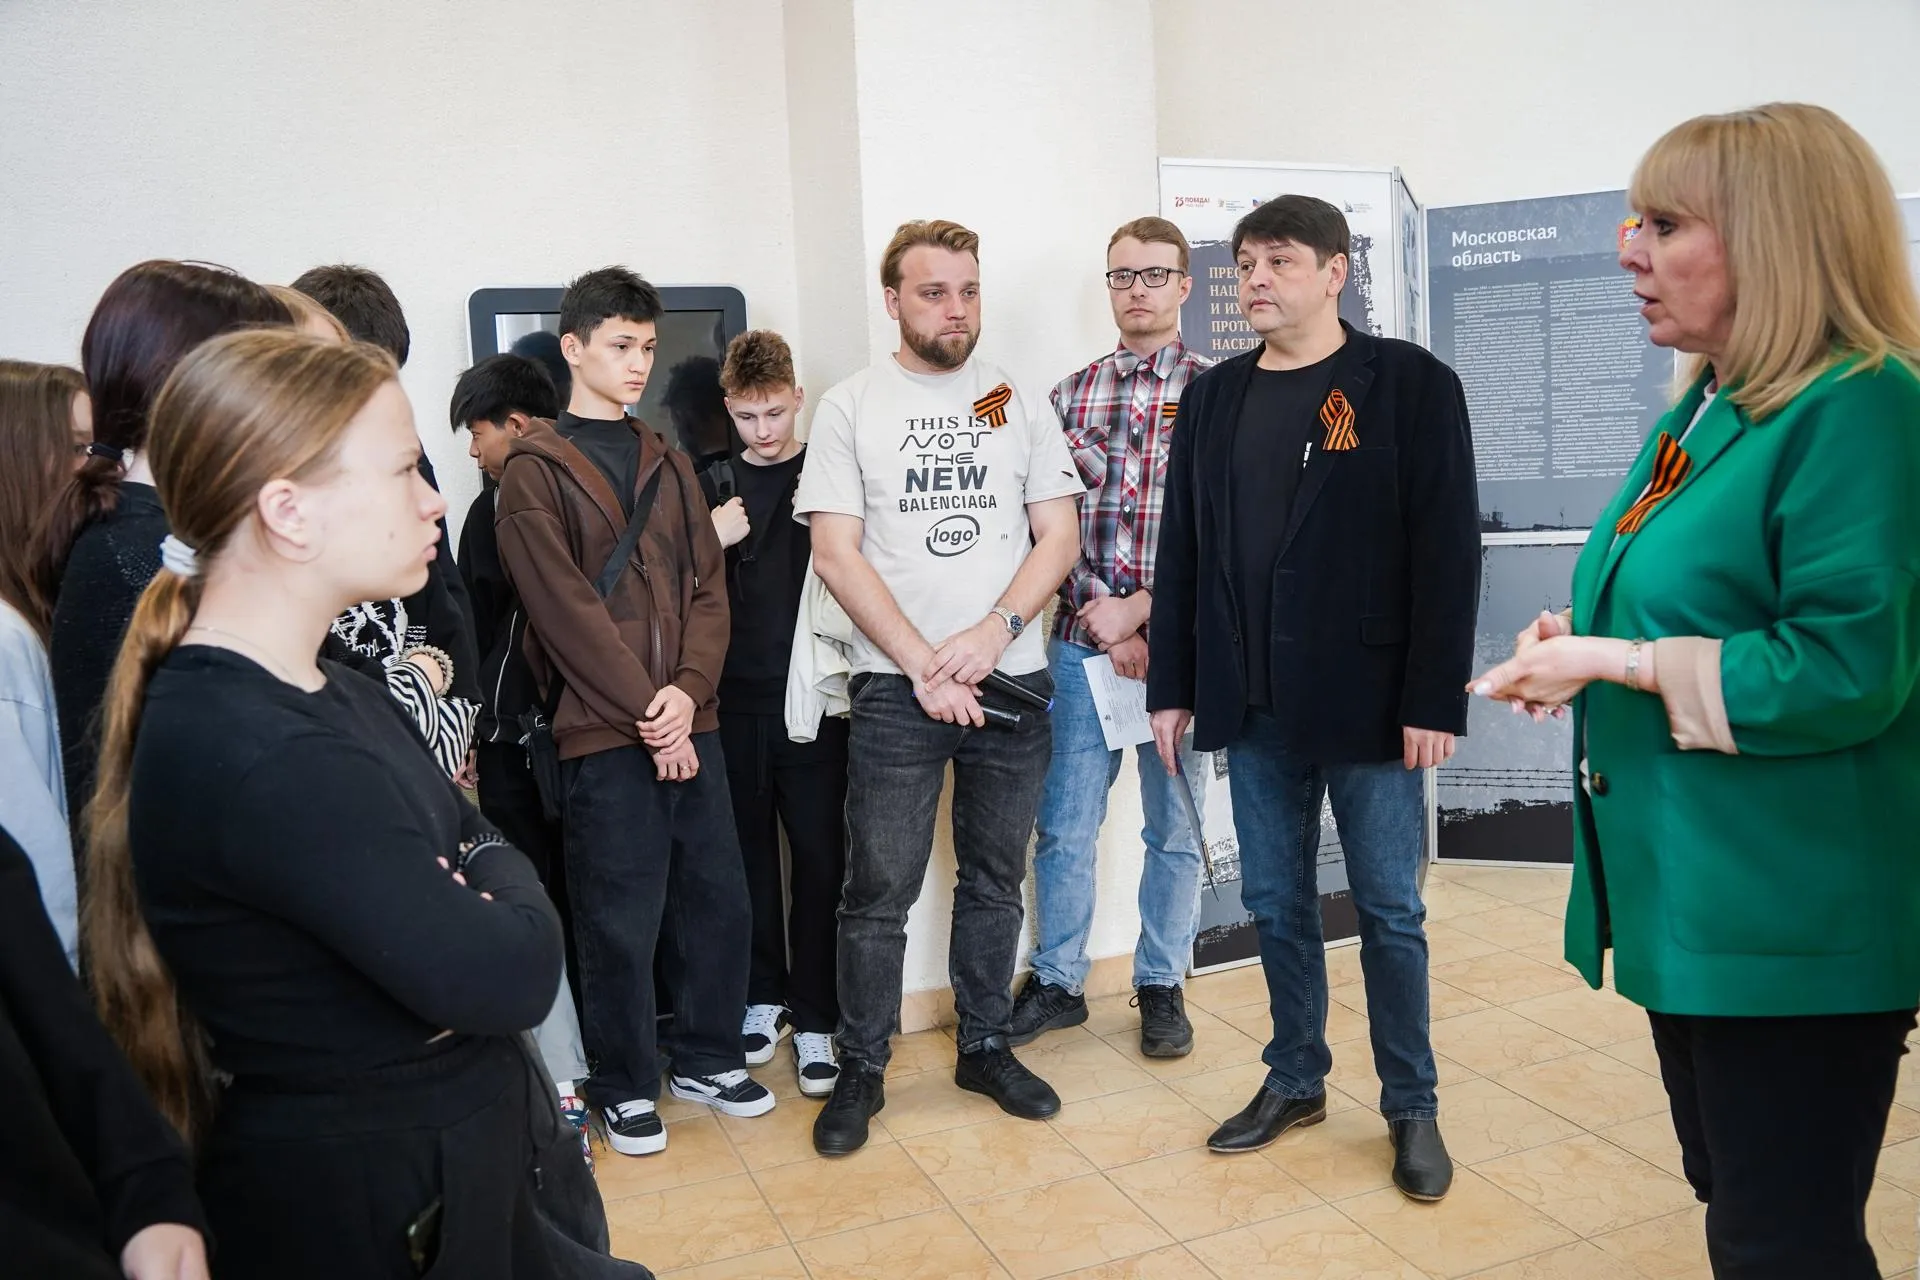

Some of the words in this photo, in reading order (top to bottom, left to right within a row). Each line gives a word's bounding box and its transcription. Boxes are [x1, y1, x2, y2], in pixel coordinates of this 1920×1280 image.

[1451, 226, 1557, 247] Московская
[1451, 250, 1521, 267] область
[1210, 302, 1221, 315] И
[1225, 302, 1242, 315] ИХ
[1212, 338, 1265, 351] НАСЕЛЕ
[905, 416, 959, 430] THIS
[968, 415, 988, 428] IS
[899, 431, 992, 451] NOT
[916, 452, 974, 465] THE
[905, 465, 988, 493] NEW
[899, 494, 997, 512] BALENCIAGA
[932, 528, 974, 546] logo
